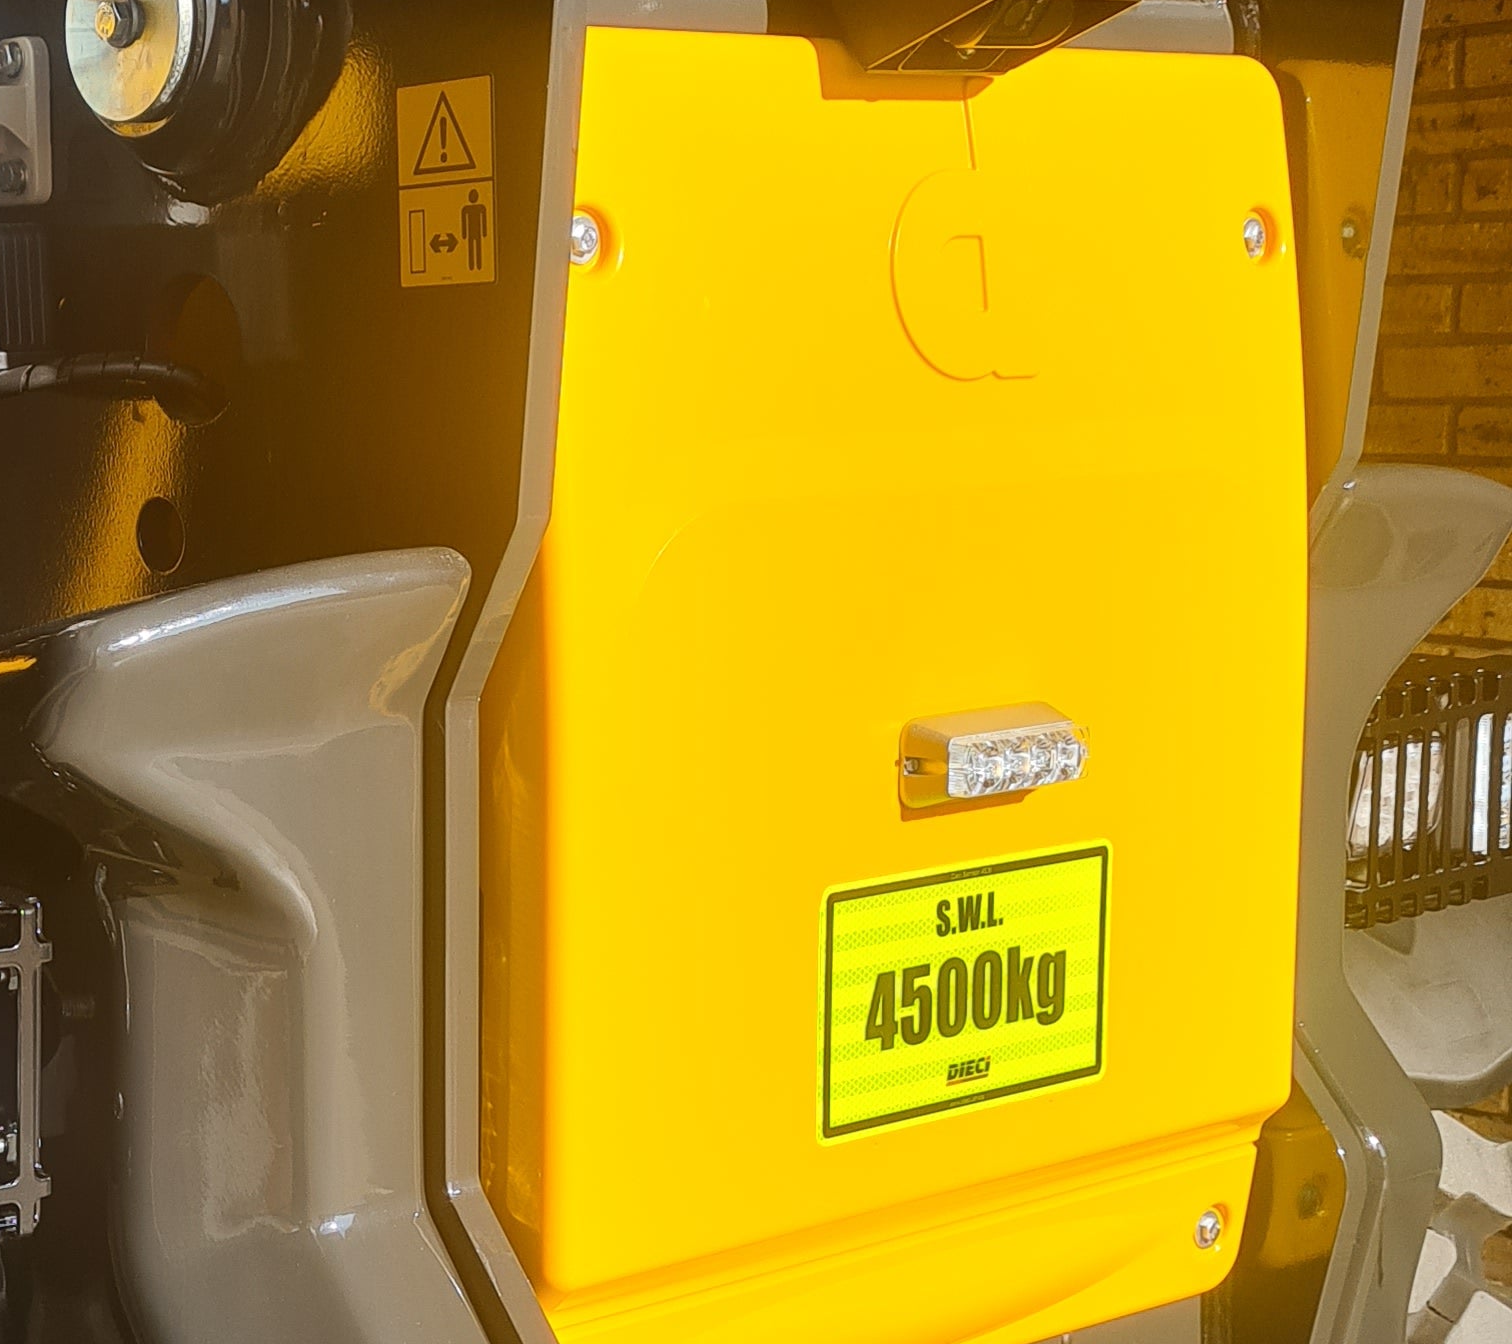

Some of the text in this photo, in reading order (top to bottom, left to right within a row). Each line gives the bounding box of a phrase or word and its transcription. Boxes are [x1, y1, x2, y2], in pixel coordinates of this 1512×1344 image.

[936, 891, 1004, 938] S.W.L.
[864, 945, 1067, 1051] 4500kg
[946, 1055, 991, 1081] DIECI
